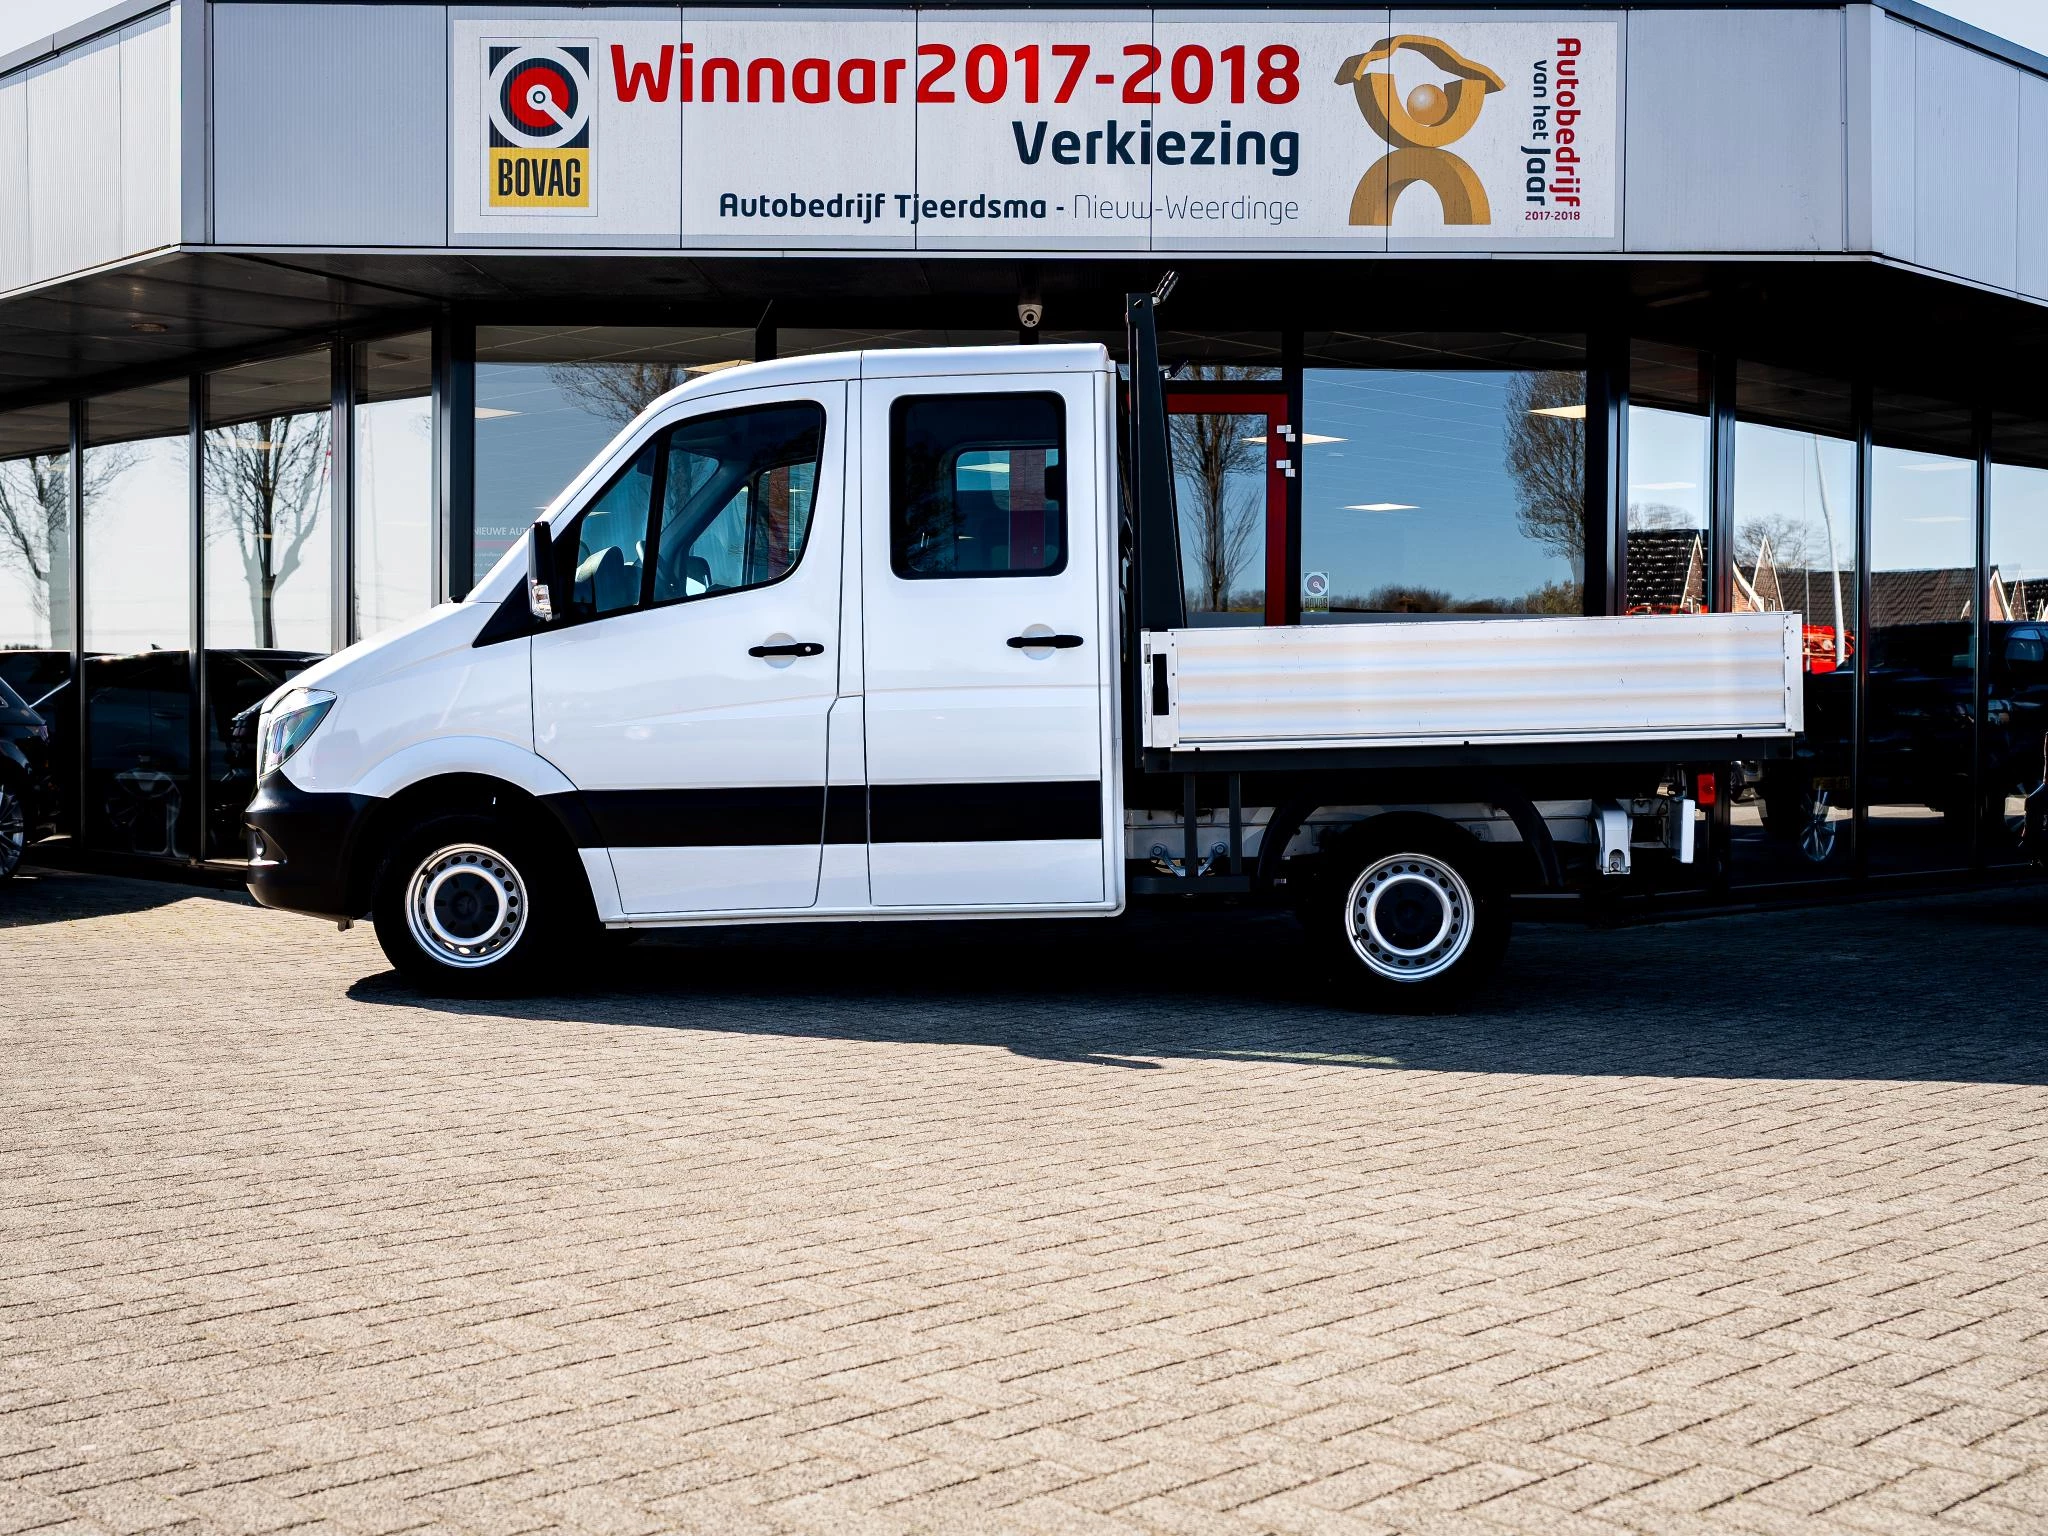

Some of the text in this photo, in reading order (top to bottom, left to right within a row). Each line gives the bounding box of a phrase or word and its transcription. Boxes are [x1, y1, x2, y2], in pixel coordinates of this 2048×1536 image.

[610, 43, 1301, 105] Winnaar 2017-2018
[1520, 59, 1551, 207] van het Jaar
[1549, 38, 1582, 207] Autobedrijf
[1011, 119, 1300, 177] Verkiezing
[498, 157, 582, 197] BOVAG
[719, 192, 886, 224] Autobedrijf
[894, 193, 1047, 224] Tjeerdsma
[1074, 194, 1299, 226] Nieuw-Weerdinge
[1524, 211, 1581, 221] 2017-2018
[474, 527, 507, 536] NIEUWE
